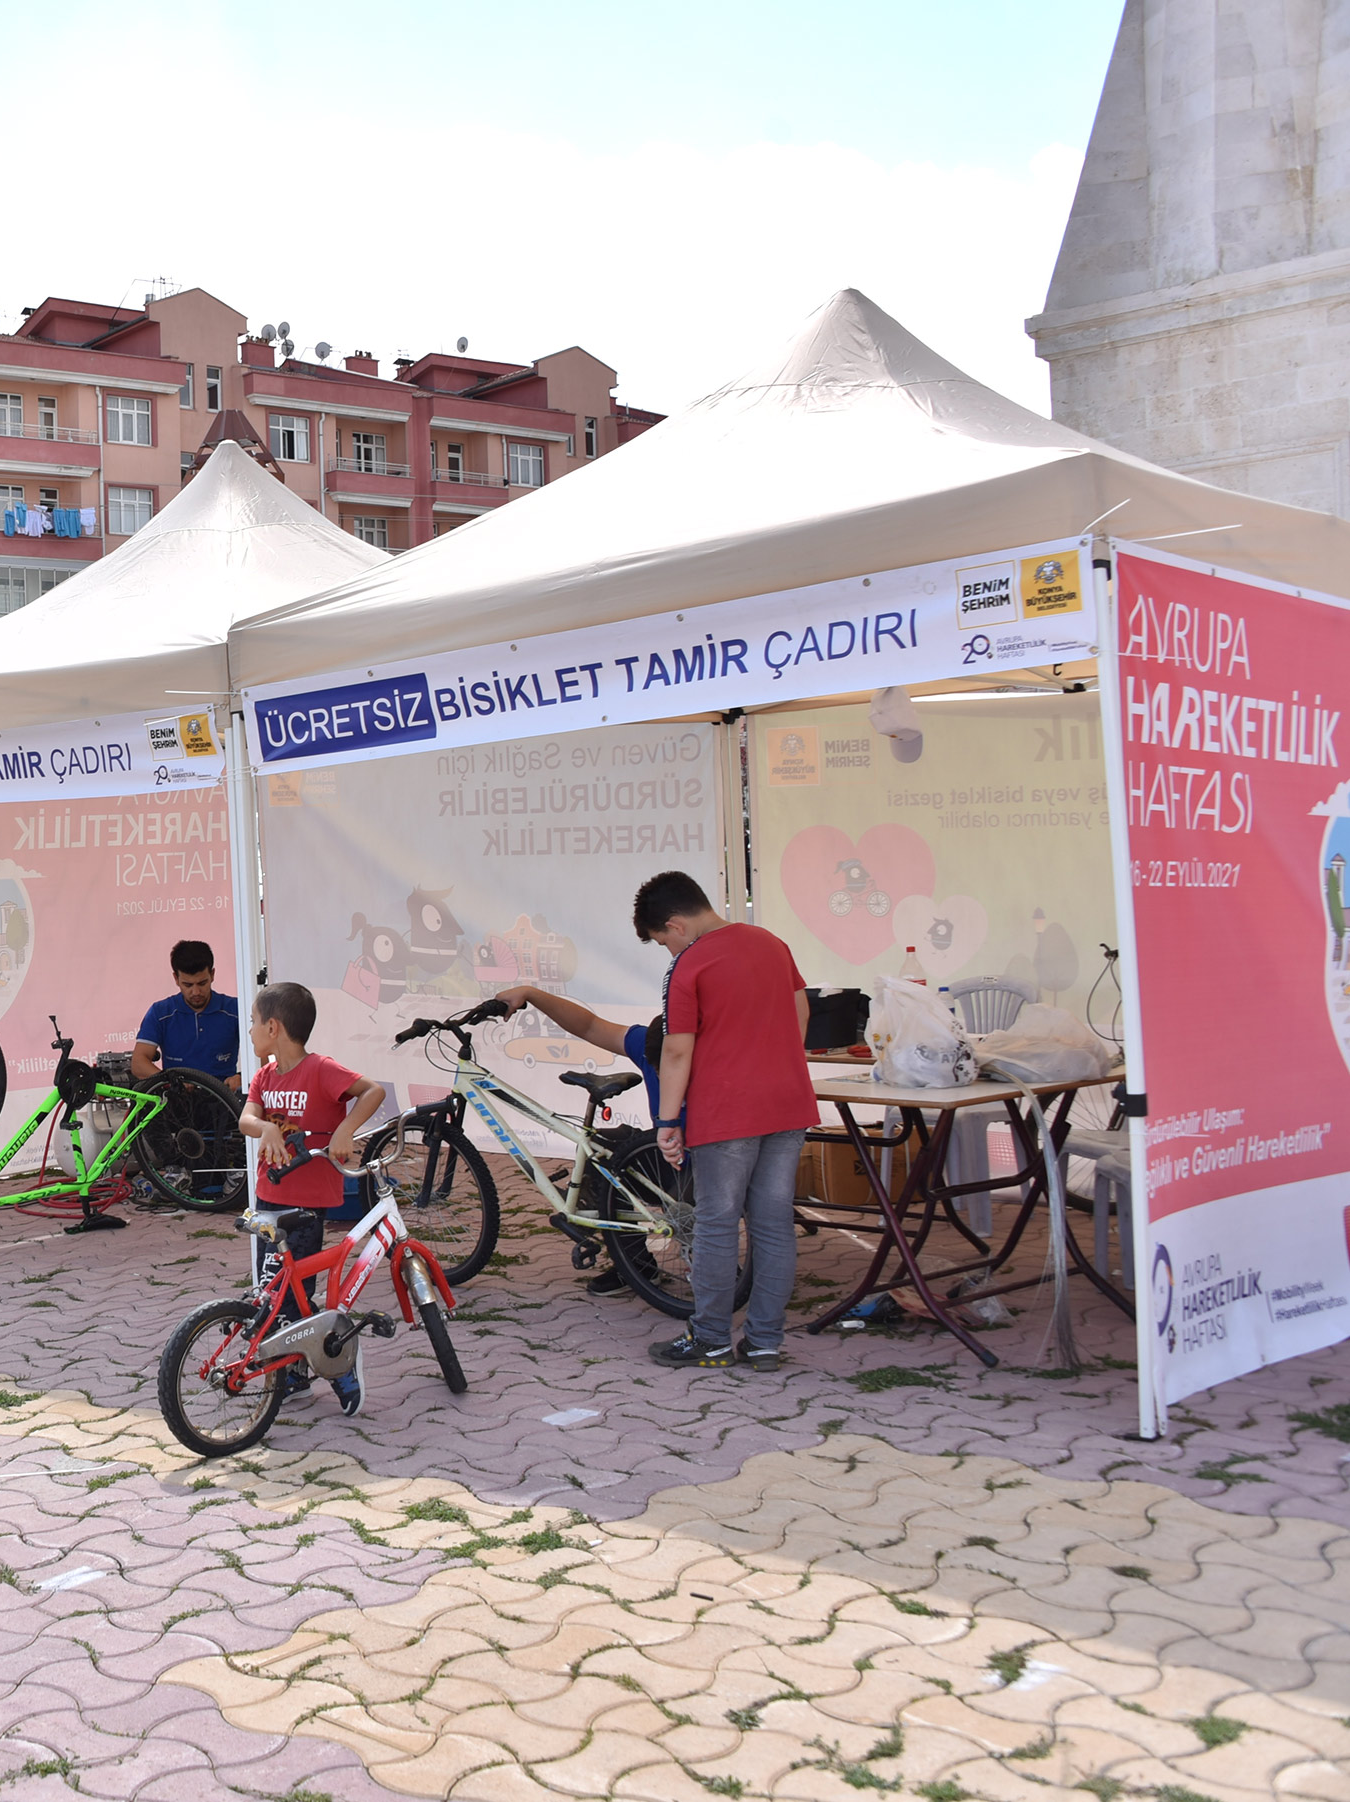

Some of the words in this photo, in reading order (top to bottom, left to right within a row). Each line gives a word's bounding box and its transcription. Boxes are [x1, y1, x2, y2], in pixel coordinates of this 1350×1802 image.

[1125, 594, 1250, 680] AVRUPA
[264, 688, 429, 748] ÜCRETSİZ
[434, 662, 604, 722] BİSİKLET
[614, 633, 749, 693] TAMİR
[764, 608, 918, 680] ÇADIRI
[1126, 676, 1341, 768] HAREKETLİLİK
[50, 742, 132, 784] ÇADIRI
[1128, 760, 1253, 834] HAFTASI
[1207, 862, 1241, 888] 2021
[1174, 1156, 1189, 1181] ve
[1192, 1138, 1245, 1176] Güvenli
[1182, 1252, 1222, 1291] AVRUPA
[1182, 1267, 1262, 1323] HAREKETLİLİK
[285, 1327, 315, 1344] COBRA
[1182, 1312, 1228, 1354] HAFTASI
